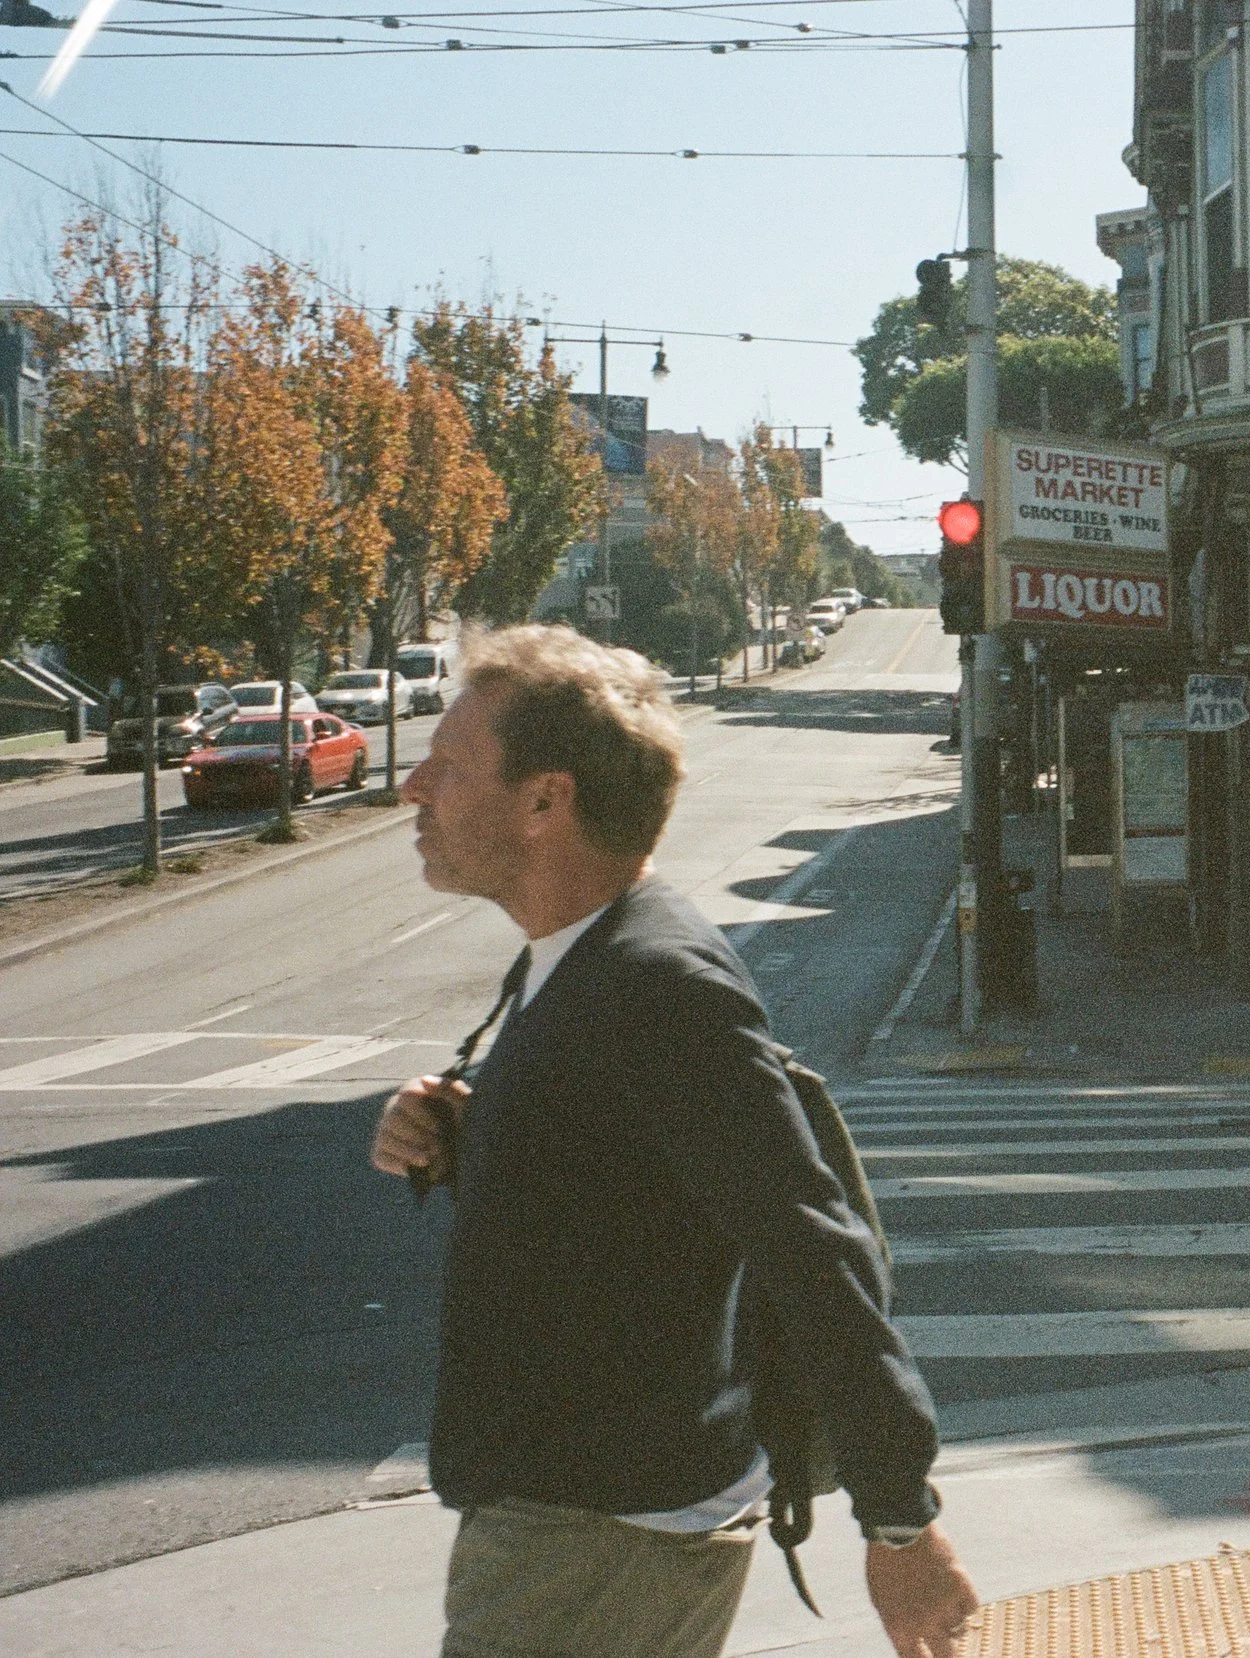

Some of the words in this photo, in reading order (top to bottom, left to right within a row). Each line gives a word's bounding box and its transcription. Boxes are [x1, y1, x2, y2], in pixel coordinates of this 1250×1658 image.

[1015, 448, 1163, 487] SUPERETTE
[1034, 476, 1144, 509] MARKET
[1018, 504, 1109, 526] GROCERIES
[1119, 514, 1161, 533] WINE
[1072, 525, 1113, 542] BEER
[1015, 571, 1164, 618] LIQUOR
[1189, 703, 1242, 724] ATM
